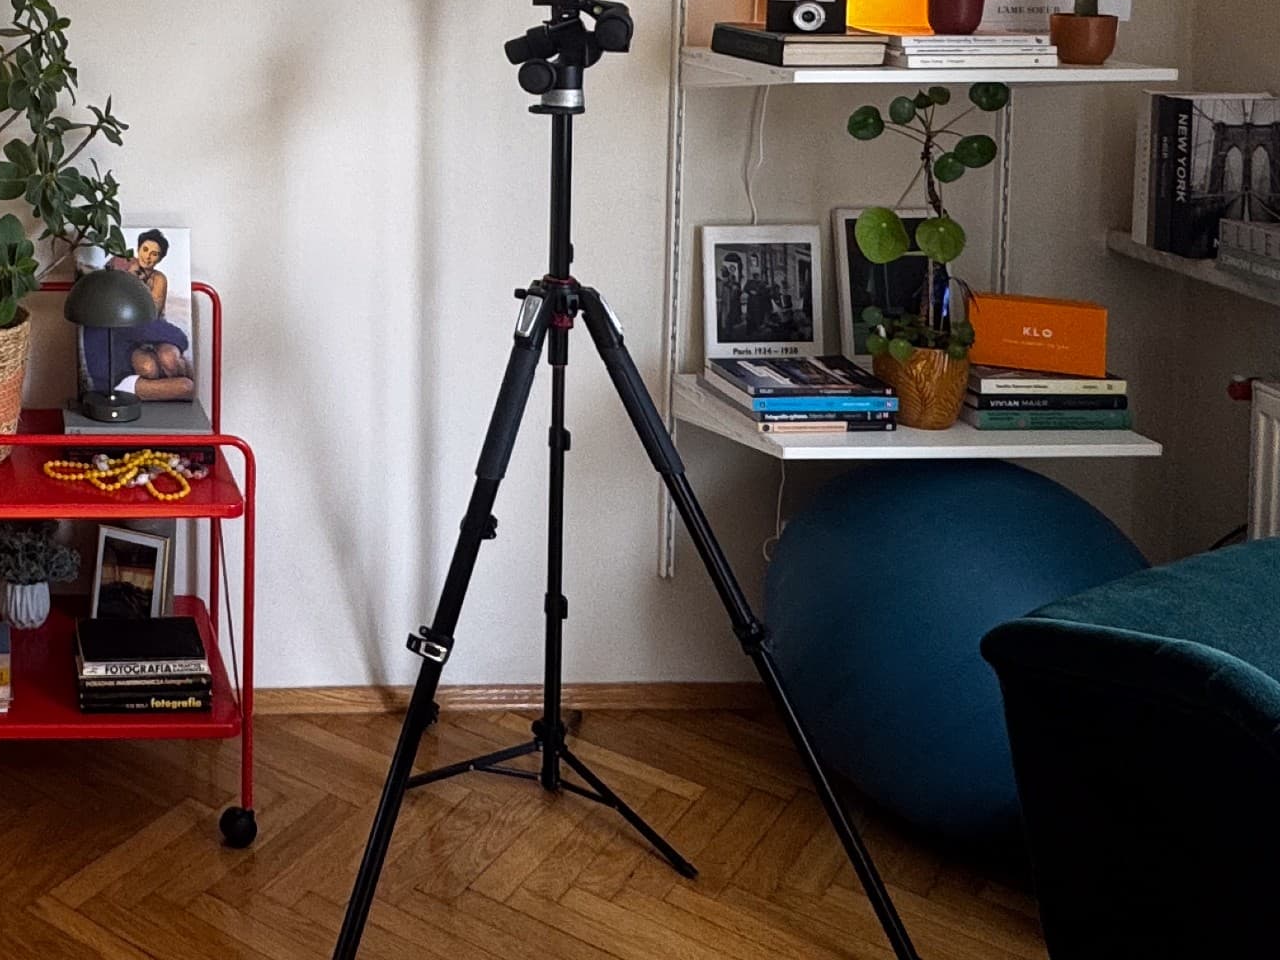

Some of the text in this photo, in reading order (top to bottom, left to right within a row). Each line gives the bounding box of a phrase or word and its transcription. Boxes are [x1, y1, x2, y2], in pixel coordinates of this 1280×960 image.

[1175, 113, 1189, 203] NEW YORK
[732, 347, 752, 355] Paris
[989, 399, 1020, 407] VIVIAN
[104, 663, 172, 674] FOTOGRAFIA
[150, 696, 202, 709] fotografia
